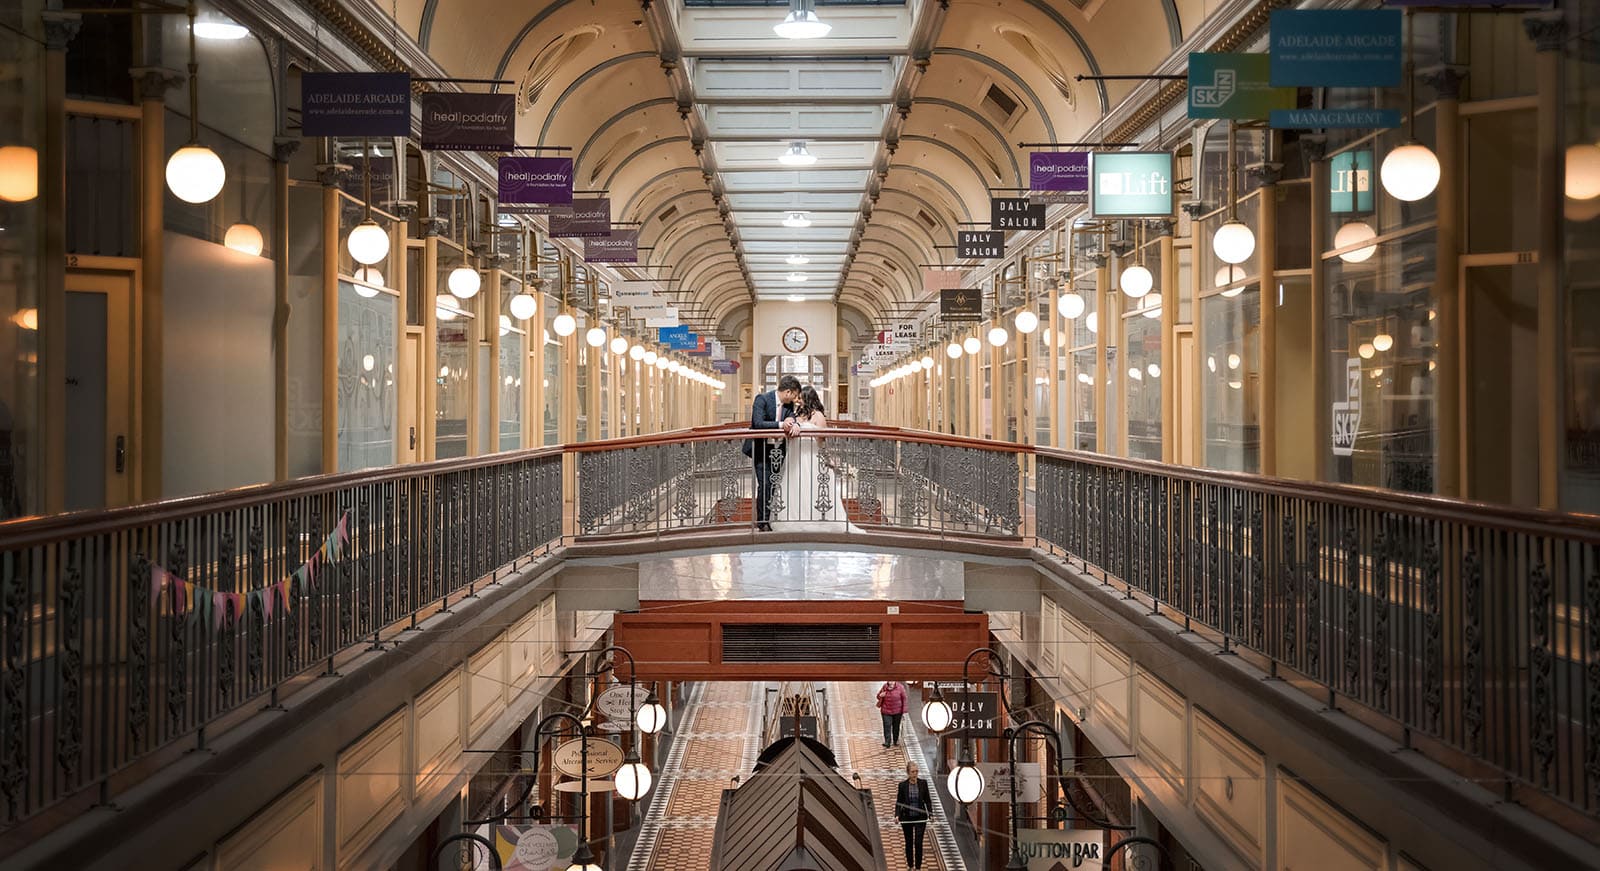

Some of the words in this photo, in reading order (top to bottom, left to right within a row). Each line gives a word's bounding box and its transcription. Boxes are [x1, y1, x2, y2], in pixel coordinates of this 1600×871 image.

[1278, 35, 1341, 48] ADELAIDE
[1344, 34, 1397, 48] ARCADE
[307, 94, 362, 104] ADELAIDE
[363, 94, 406, 104] ARCADE
[1288, 112, 1384, 125] MANAGEMENT
[1122, 171, 1168, 195] Lift
[1000, 201, 1029, 211] DALY
[1000, 217, 1037, 227] SALON
[965, 234, 991, 243] DALY
[965, 247, 998, 256] SALON
[952, 702, 983, 712] DALY
[952, 719, 993, 729] SALON
[1018, 842, 1071, 866] BUTTON
[1073, 841, 1100, 868] BAR
